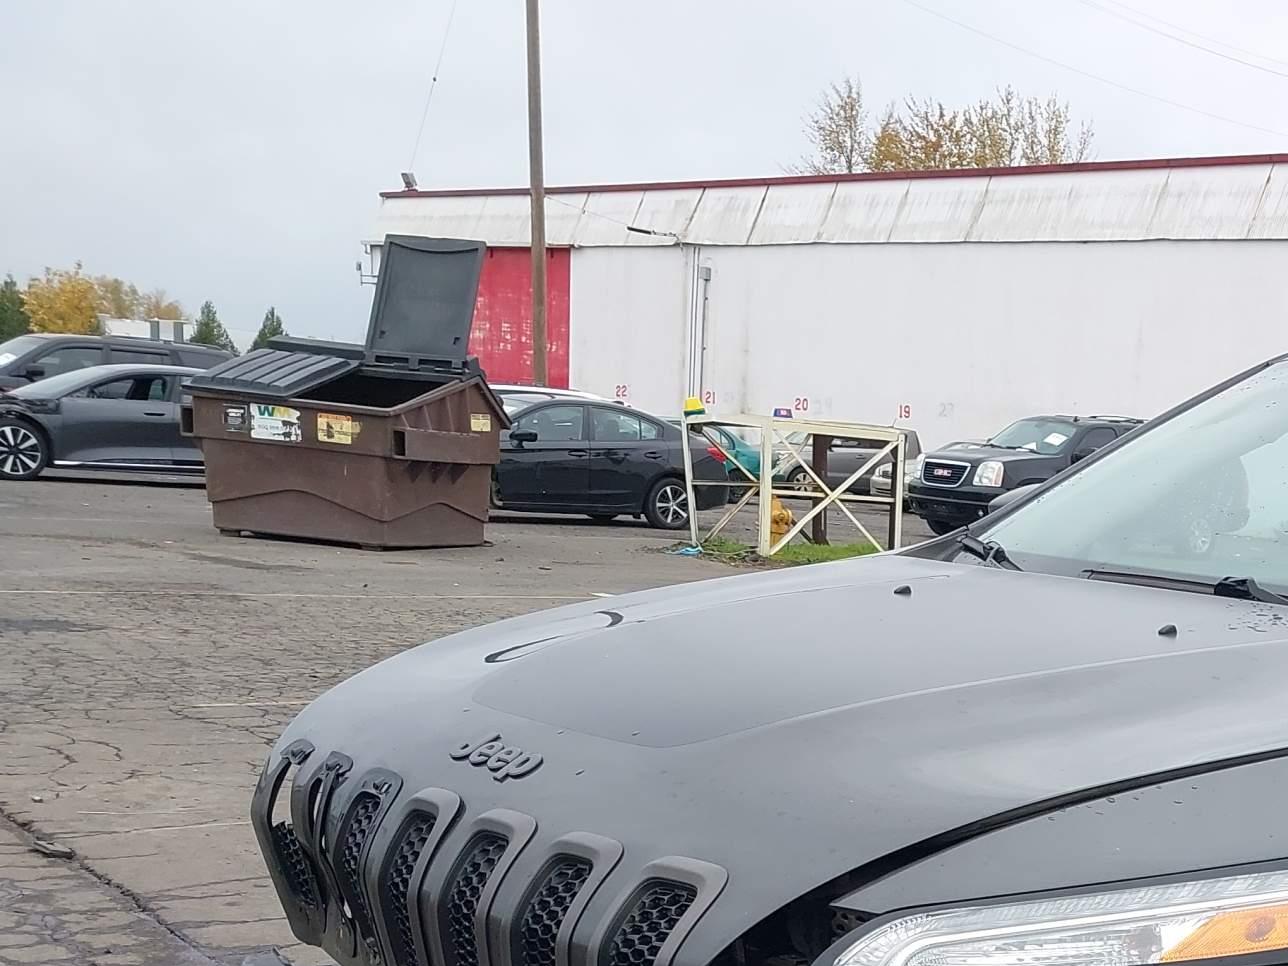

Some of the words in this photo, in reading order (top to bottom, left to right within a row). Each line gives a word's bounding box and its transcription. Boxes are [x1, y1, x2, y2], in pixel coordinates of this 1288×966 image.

[615, 385, 628, 397] 22
[705, 391, 716, 404] 21
[795, 398, 809, 411] 20
[899, 405, 911, 418] 19
[449, 732, 544, 783] Jeep
